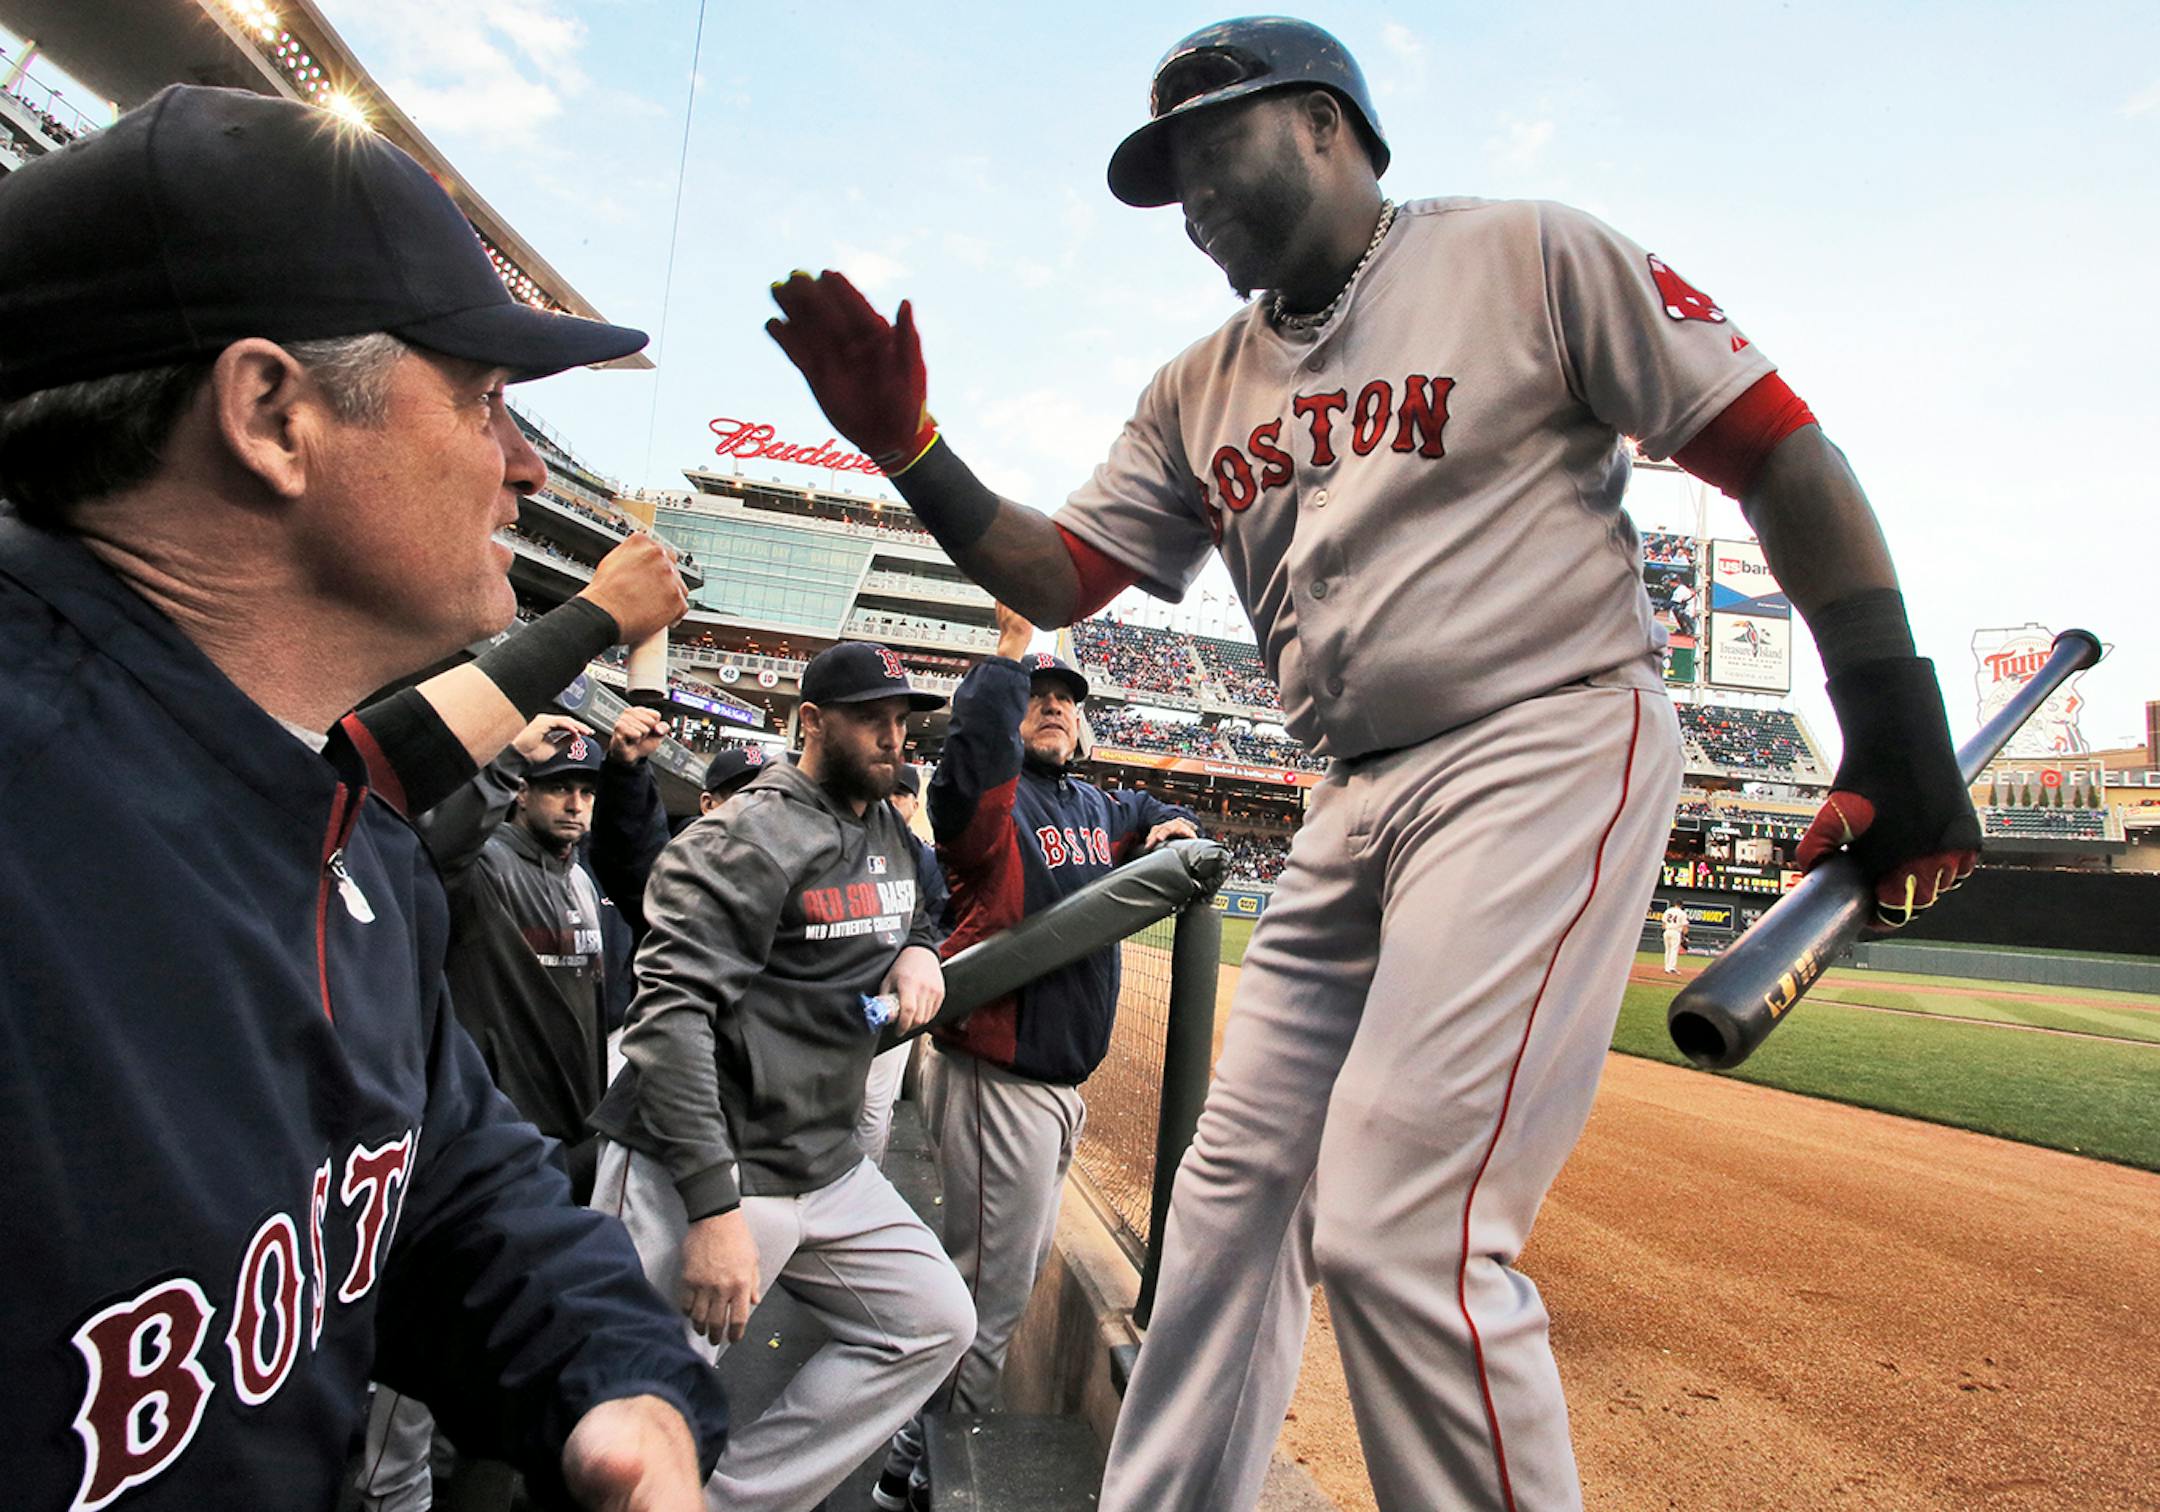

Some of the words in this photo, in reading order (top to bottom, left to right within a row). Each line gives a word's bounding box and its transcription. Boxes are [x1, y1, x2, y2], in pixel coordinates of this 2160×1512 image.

[709, 418, 887, 476] Budwe
[1193, 374, 1456, 546] OSTON
[1984, 647, 2052, 684] Twin
[1976, 770, 2034, 786] GET
[2068, 770, 2160, 787] FIELD
[803, 887, 844, 923] RED
[1667, 913, 1678, 924] 24
[1685, 908, 1731, 923] SUBWAY
[68, 1126, 422, 1512] BOST
